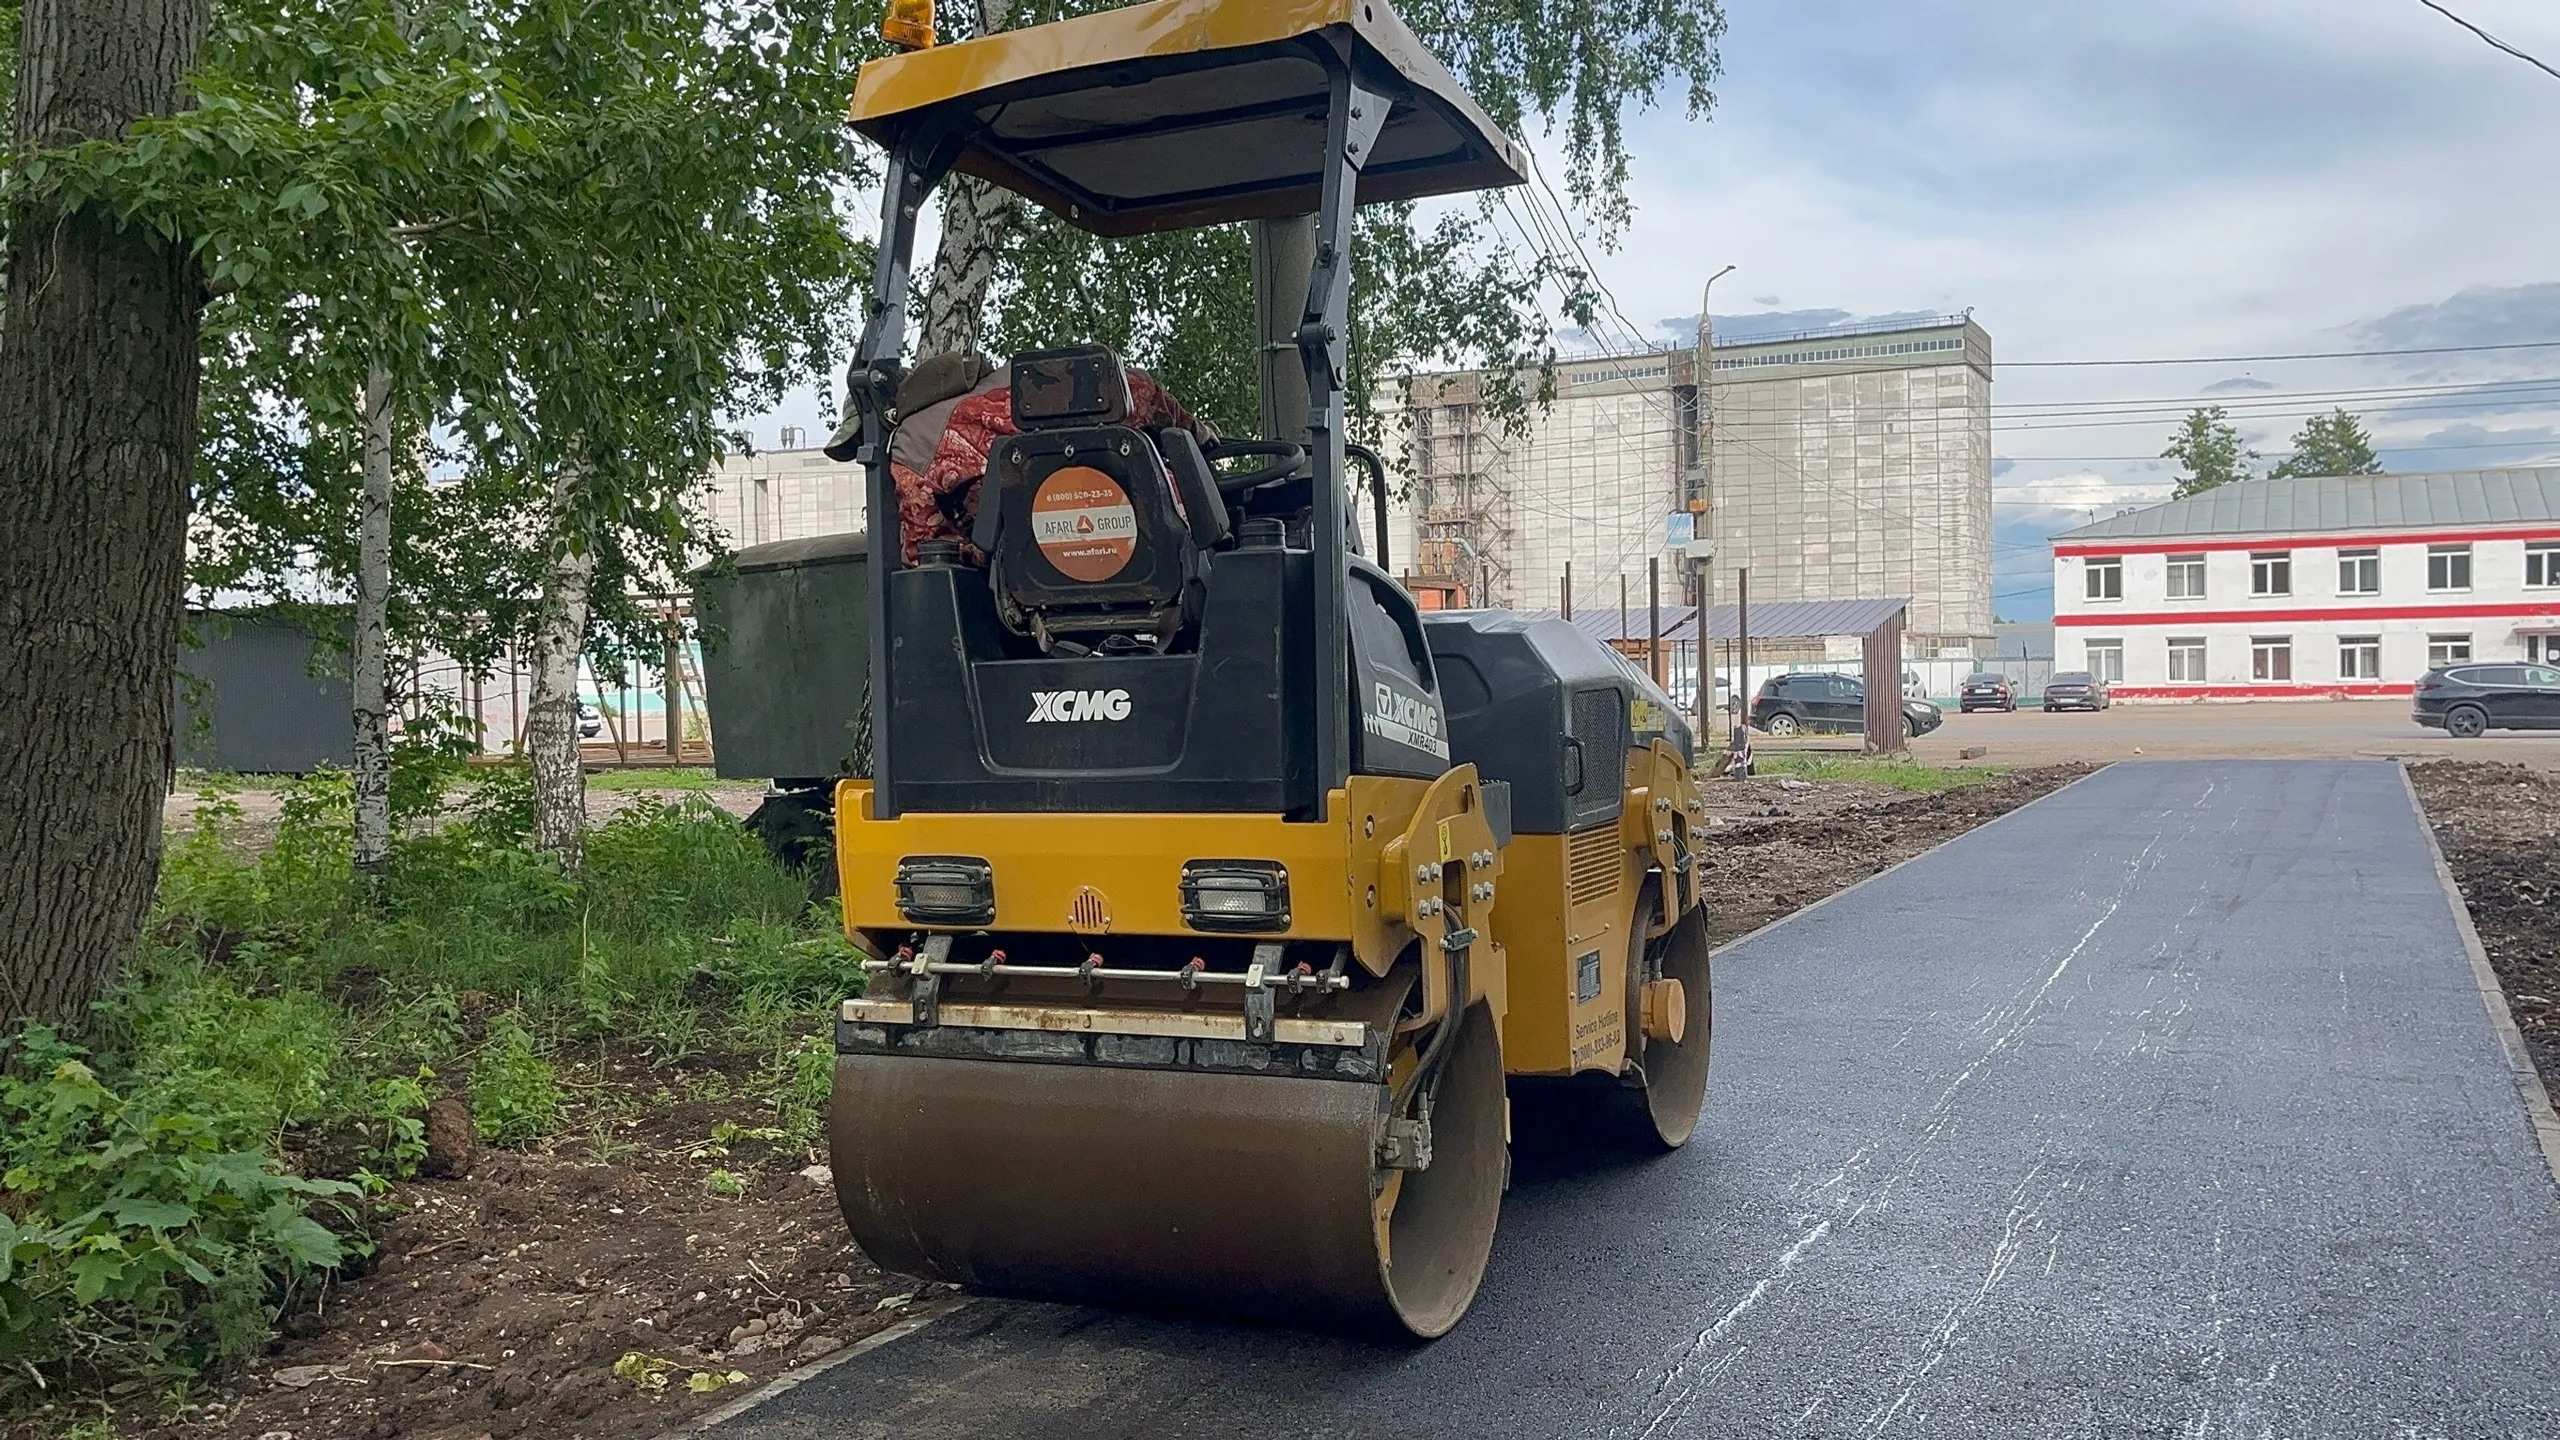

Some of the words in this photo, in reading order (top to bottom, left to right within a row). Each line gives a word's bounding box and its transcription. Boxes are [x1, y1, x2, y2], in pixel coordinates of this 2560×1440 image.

[1097, 515, 1132, 530] GROUP
[1026, 689, 1131, 723] XCMG
[1391, 692, 1438, 736] XCMG
[1407, 730, 1437, 753] XMR403
[1575, 1019, 1597, 1040] Service
